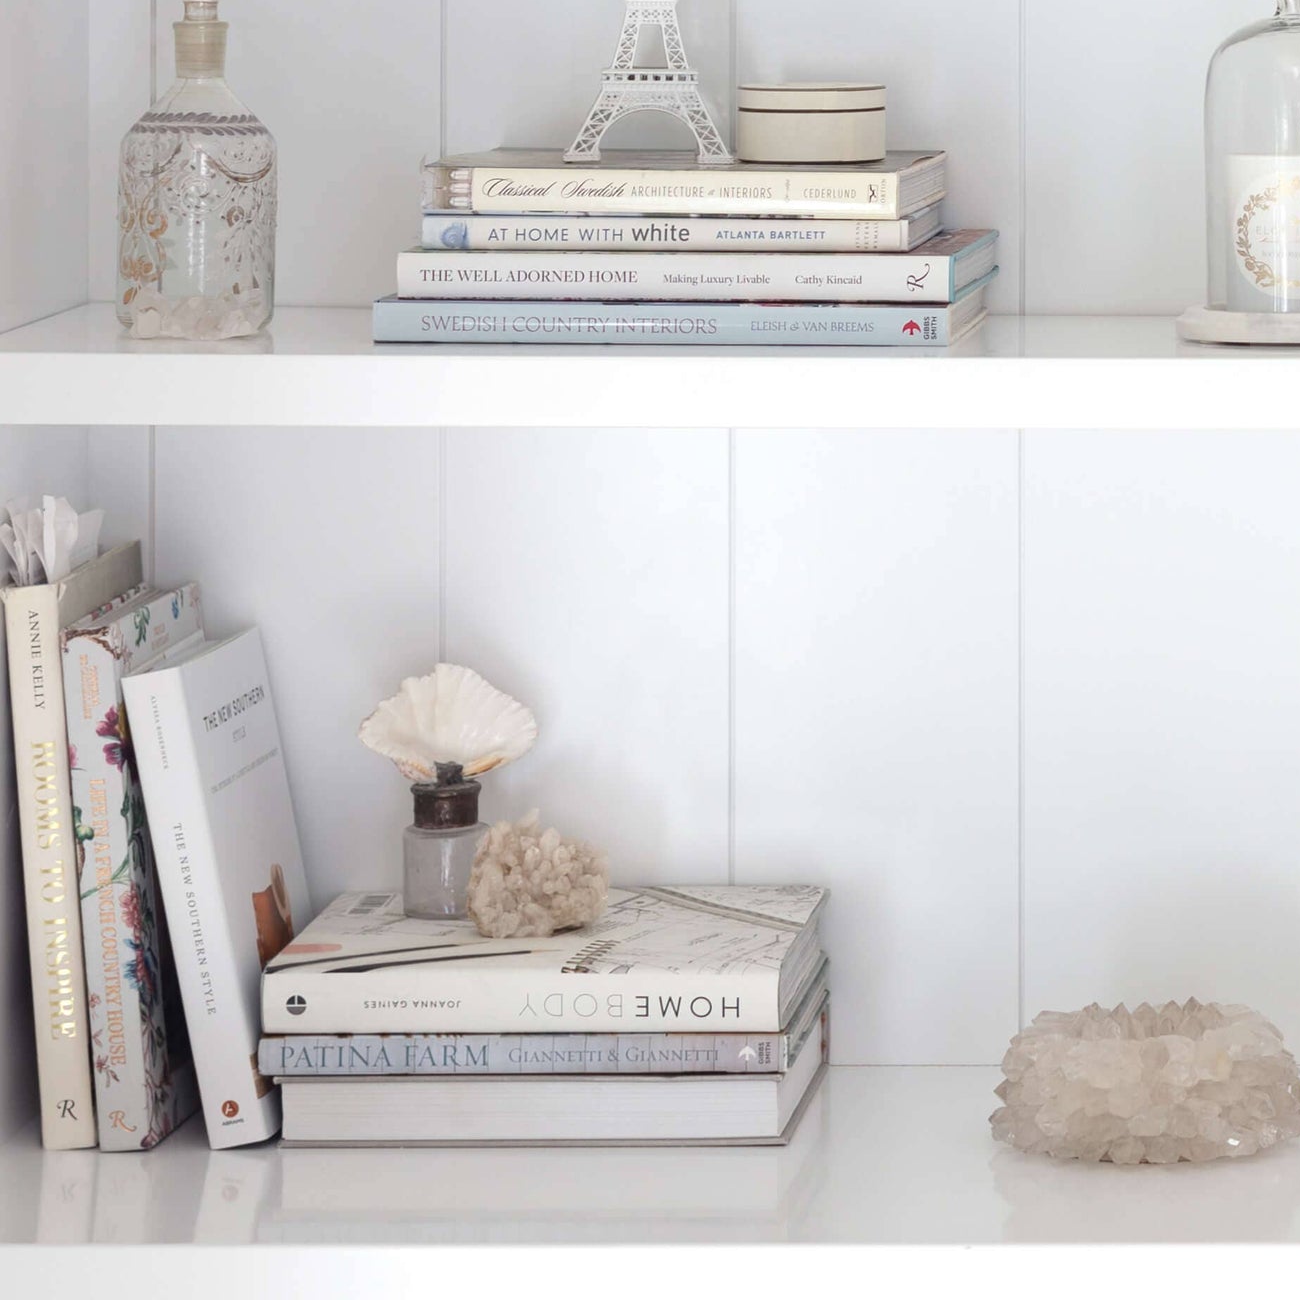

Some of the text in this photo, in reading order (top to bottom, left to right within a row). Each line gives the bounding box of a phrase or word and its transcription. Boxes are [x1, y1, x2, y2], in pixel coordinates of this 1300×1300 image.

[482, 178, 557, 198] Classical
[561, 178, 629, 198] Swedish
[631, 185, 704, 198] ARCHITECTURE
[719, 187, 772, 198] INTERIORS
[803, 188, 857, 199] CEDERLUND
[488, 223, 690, 241] AT HOME WITH white
[716, 230, 826, 240] ATLANTA BARTLETT
[420, 269, 638, 283] THE WELL ADORNED HOME
[663, 274, 771, 286] Making Luxury Livable
[795, 275, 862, 286] Cathy Kincaid
[907, 263, 930, 292] R
[421, 315, 717, 334] SWEDISH COUNTRY INTERIORS
[750, 320, 874, 332] ELEISH & VAN BREEMS
[28, 610, 46, 710] ANNIE KELLY
[203, 685, 265, 732] THE NEW SOUTHERN
[31, 741, 77, 1041] ROOMS TO INSPIRE
[89, 778, 126, 1066] LIFE IN A FRENCH COUNTRY HOUSE
[173, 823, 217, 1016] THE NEW SOUTHERN STYLE
[364, 1000, 460, 1009] JOANNA GAINES
[279, 1044, 489, 1068] PATINA FARM
[606, 1048, 620, 1062] &
[56, 1099, 77, 1120] R
[109, 1110, 136, 1133] R
